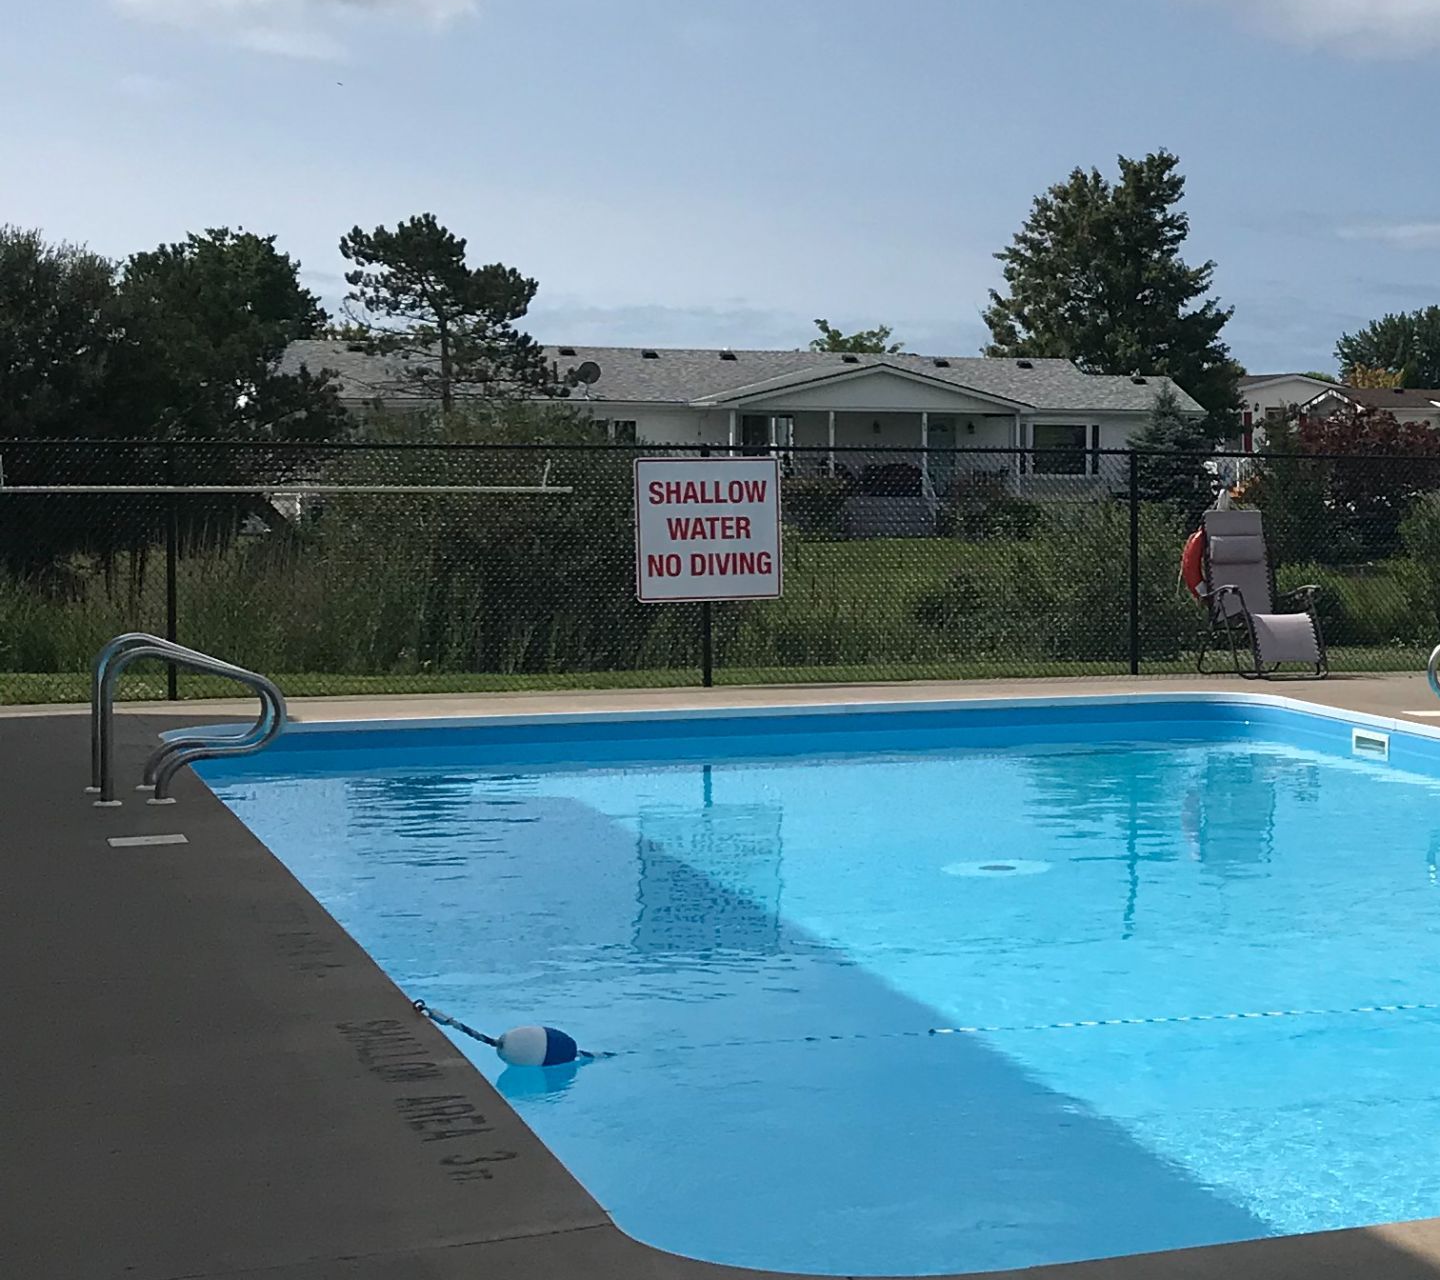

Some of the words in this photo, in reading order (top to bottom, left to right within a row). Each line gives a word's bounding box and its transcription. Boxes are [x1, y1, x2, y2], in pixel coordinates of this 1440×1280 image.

[649, 480, 767, 505] SHALLOW
[666, 516, 751, 540] WATER
[647, 554, 682, 577] NO
[690, 551, 772, 577] DIVING
[394, 1095, 495, 1143] AREA
